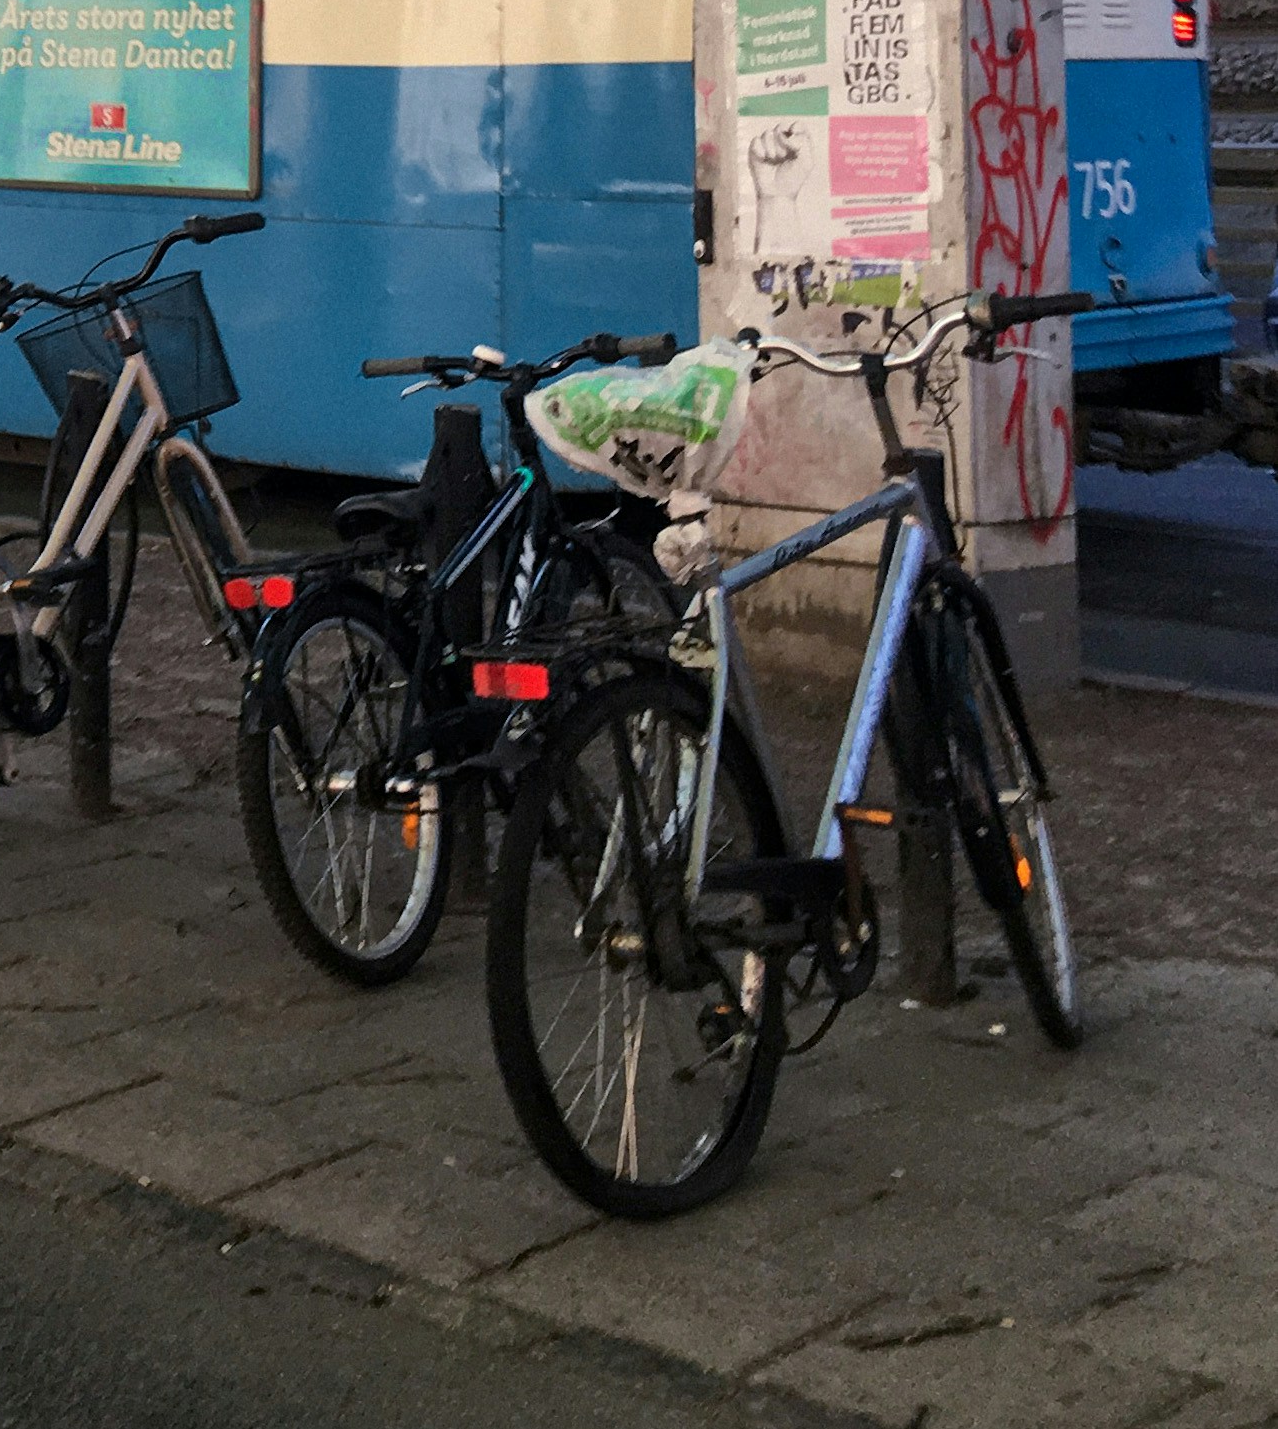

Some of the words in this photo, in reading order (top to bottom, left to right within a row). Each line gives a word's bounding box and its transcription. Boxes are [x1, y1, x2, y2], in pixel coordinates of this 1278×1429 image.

[75, 3, 146, 31] stora
[152, 0, 237, 40] nyhet
[849, 12, 905, 36] FEM
[0, 34, 34, 75] på
[39, 38, 118, 69] Stena
[124, 38, 237, 70] Danica!
[848, 61, 901, 82] TAS
[846, 82, 901, 105] GBG
[1072, 157, 1138, 220] 756
